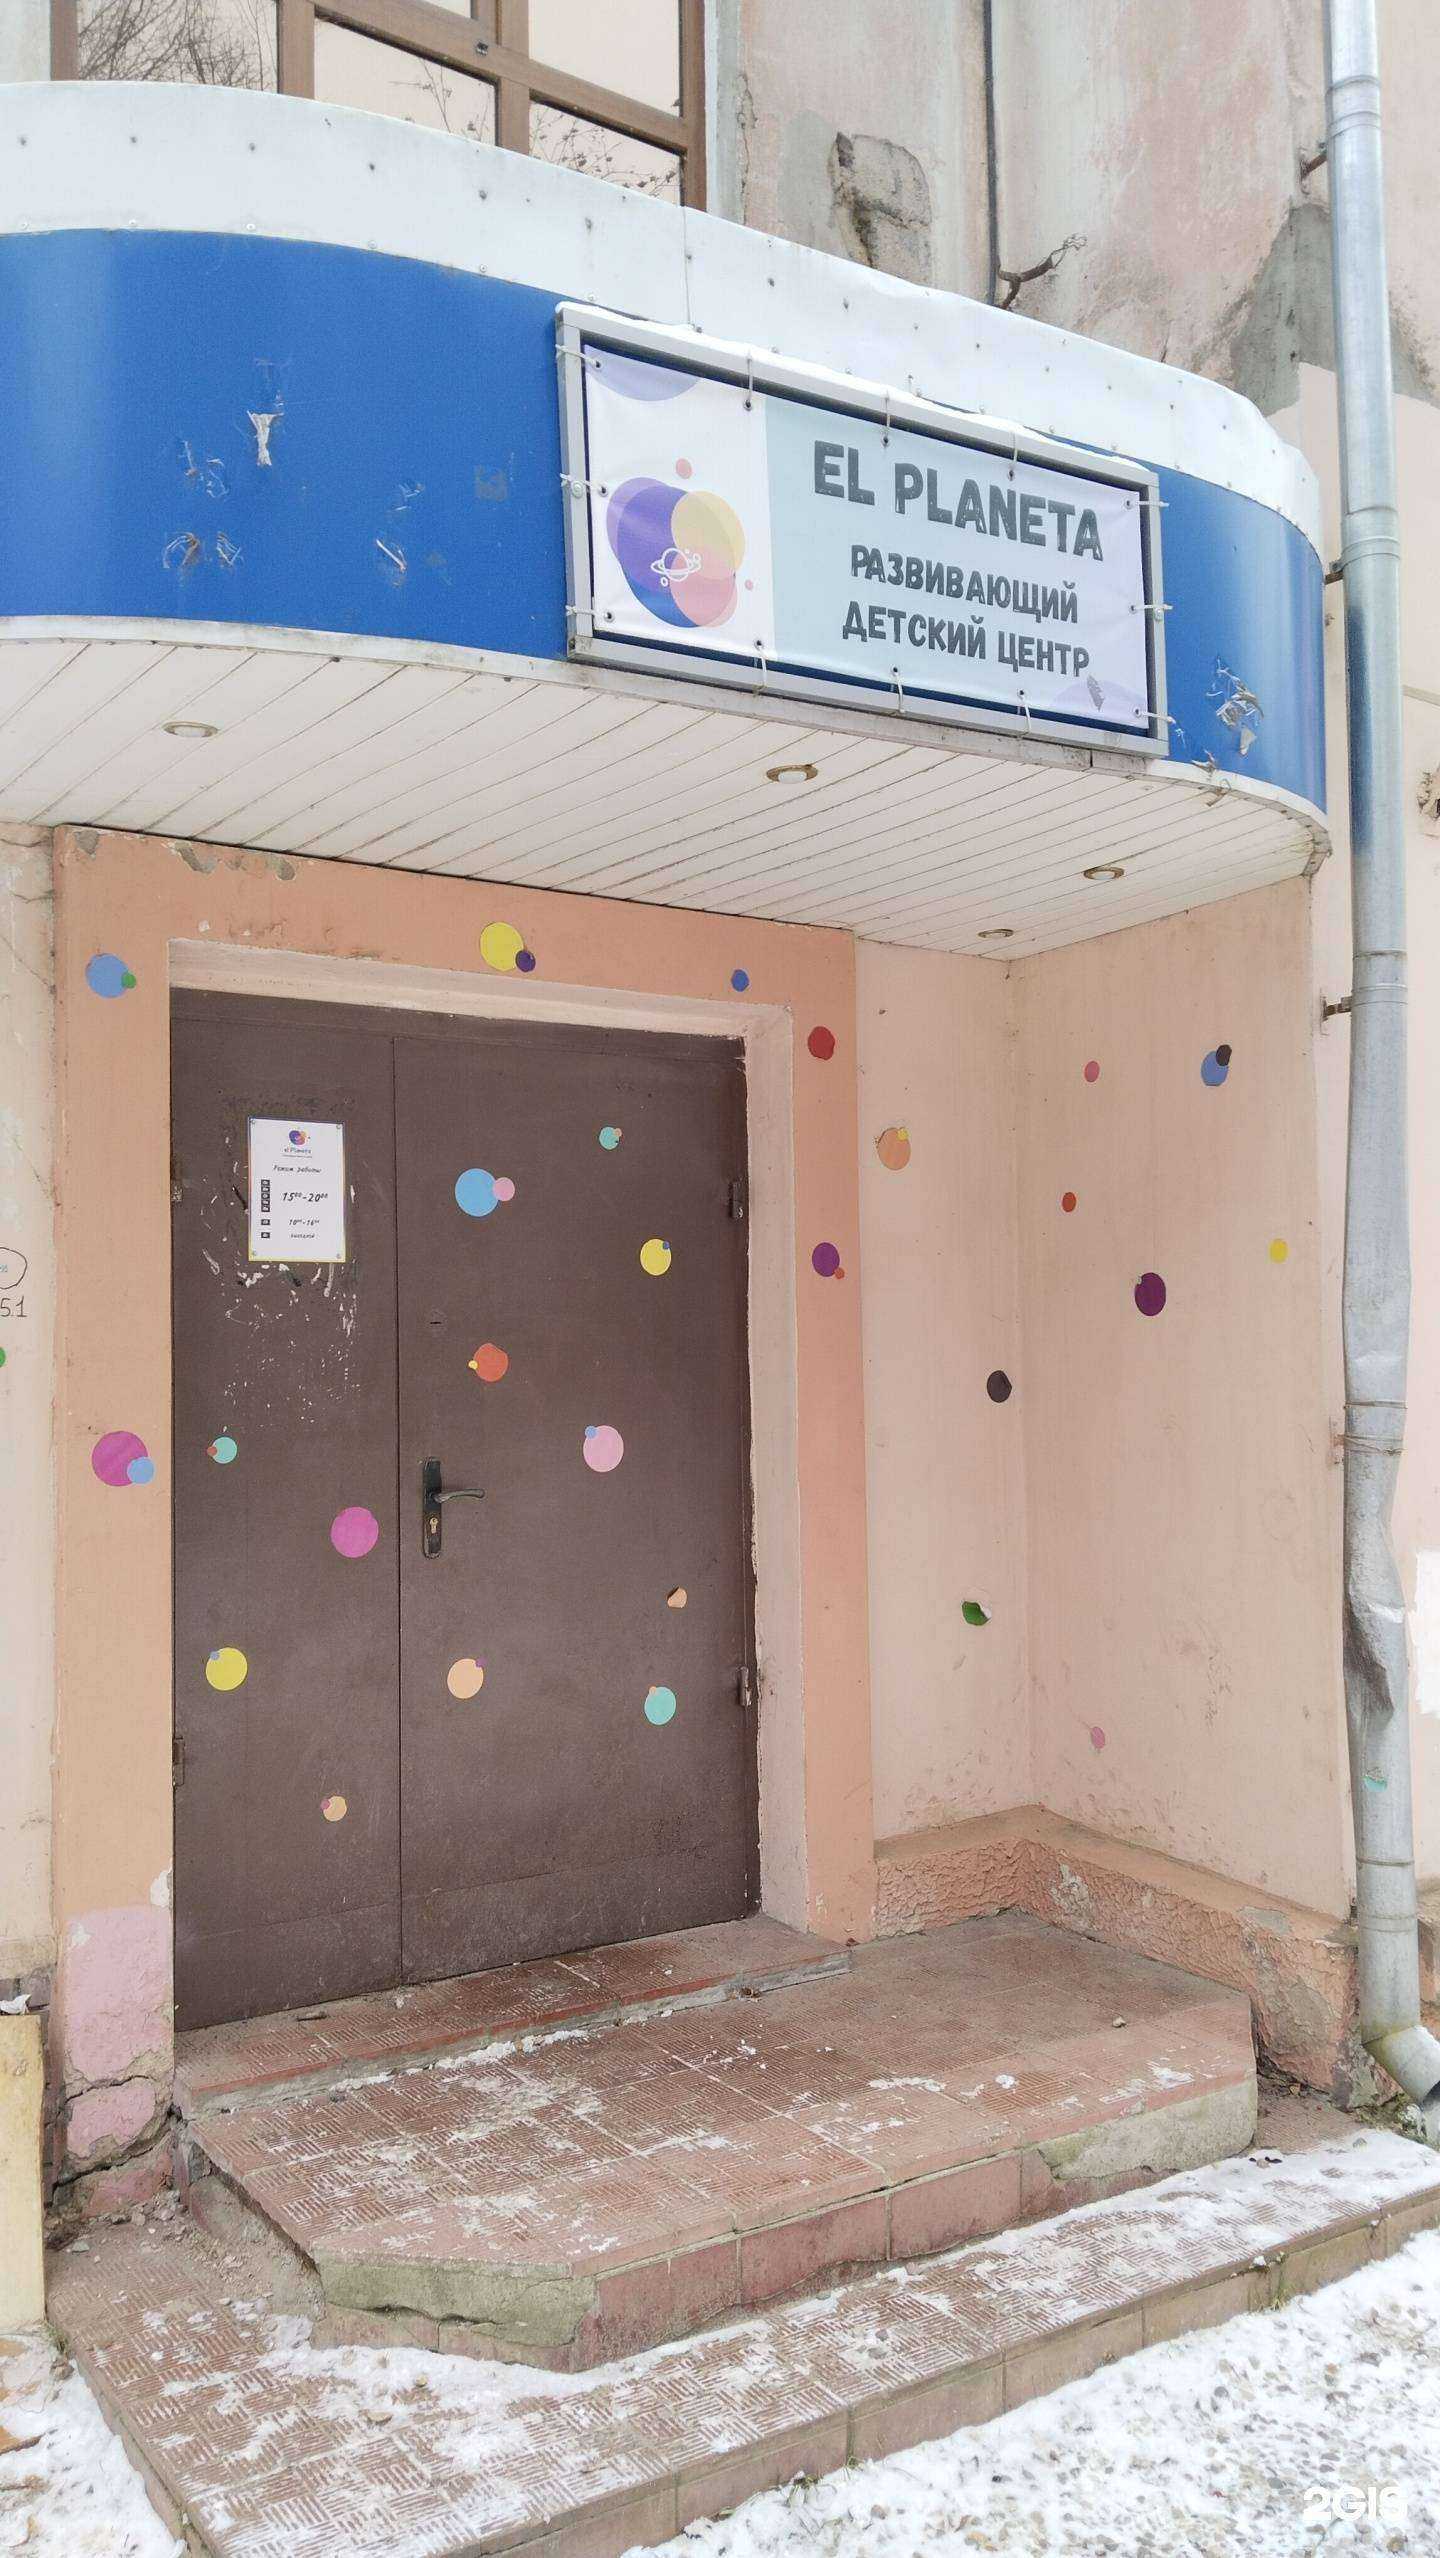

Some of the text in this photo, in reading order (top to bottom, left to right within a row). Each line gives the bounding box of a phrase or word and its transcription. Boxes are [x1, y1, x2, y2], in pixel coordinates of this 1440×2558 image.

[813, 439, 1104, 562] EL PLANETA
[849, 543, 1078, 624] РАЗВИВАЮЩИЙ
[842, 600, 1091, 678] ДЕТСКИЙ ЦЕНТР
